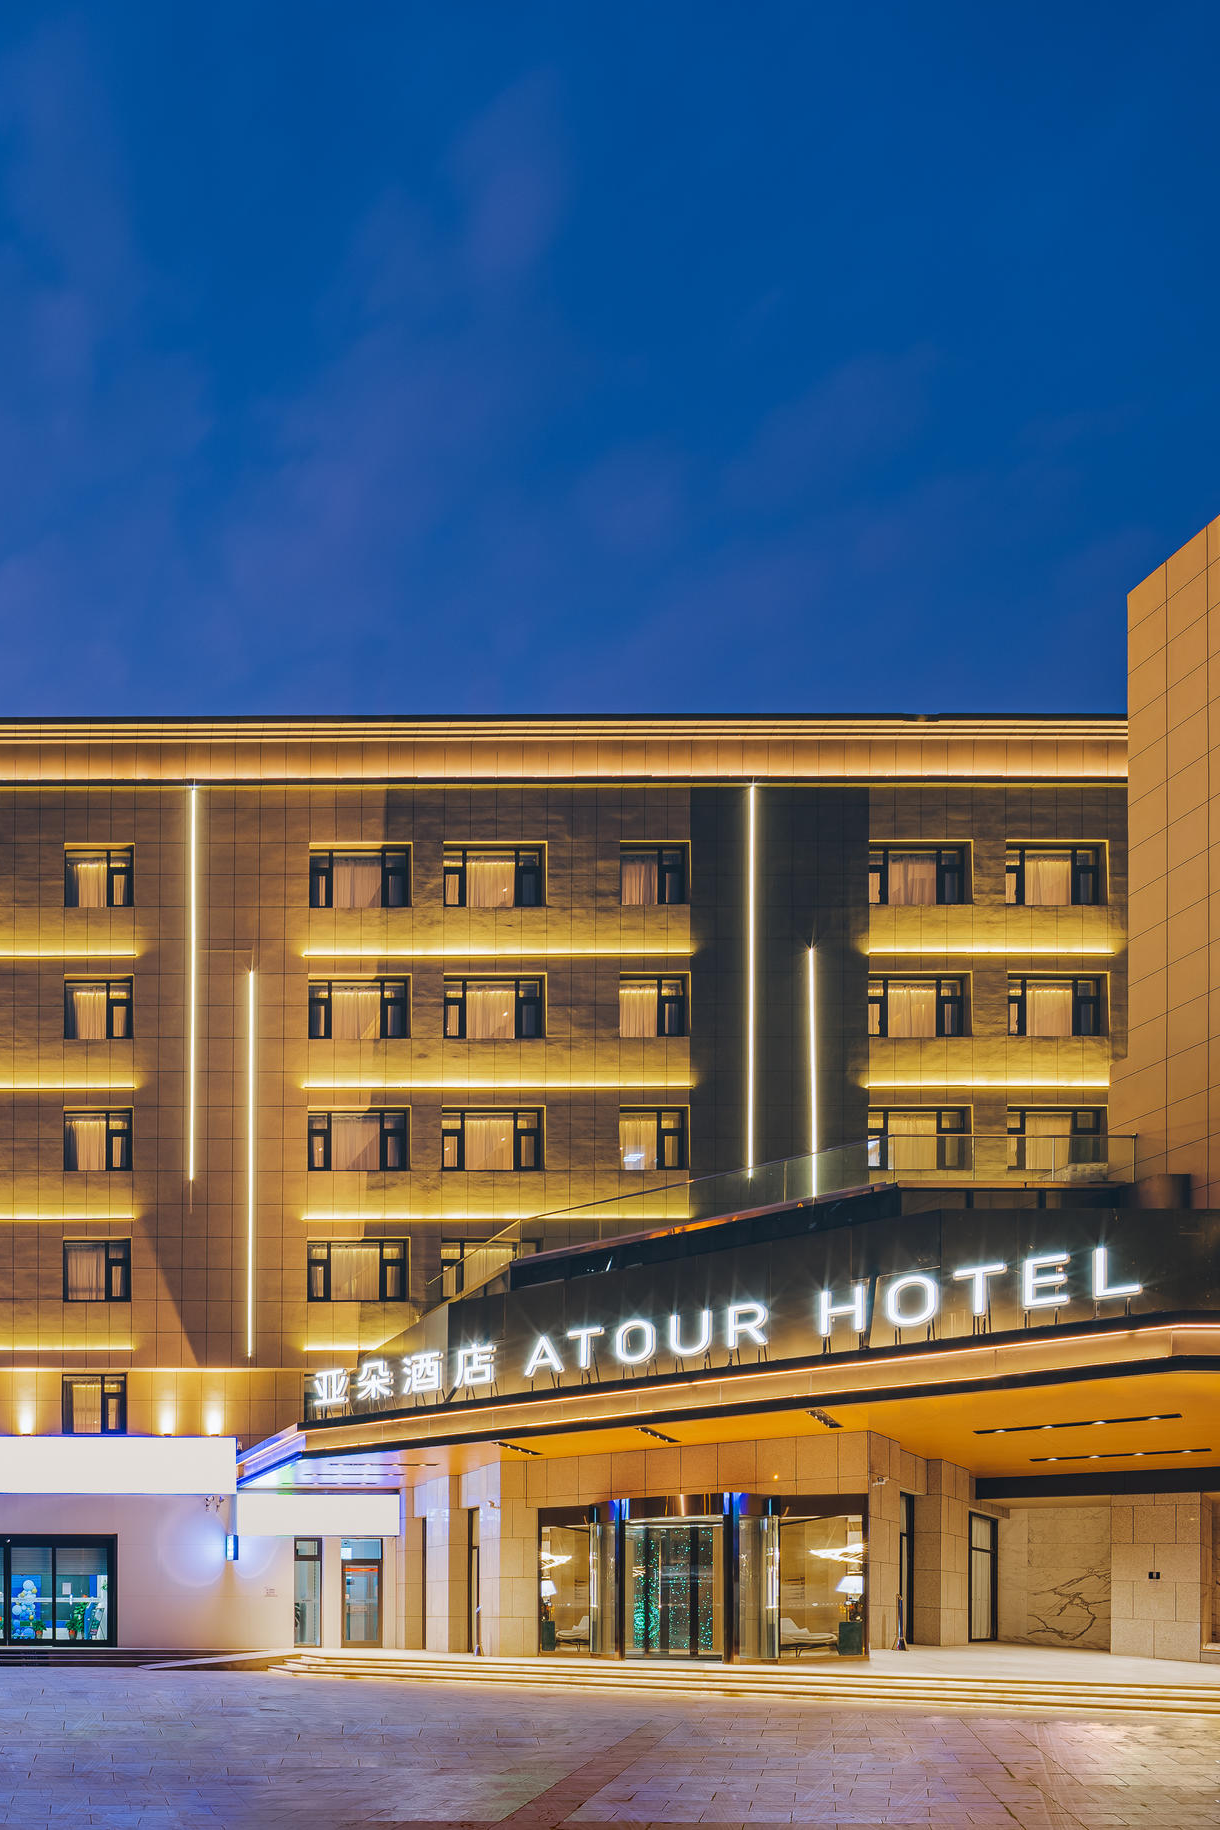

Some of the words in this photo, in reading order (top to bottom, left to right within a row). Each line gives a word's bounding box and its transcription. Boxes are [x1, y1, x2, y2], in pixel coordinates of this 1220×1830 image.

[313, 1343, 497, 1406] 亚朵酒店
[524, 1301, 769, 1378] ATOUR
[818, 1246, 1144, 1338] HOTEL
